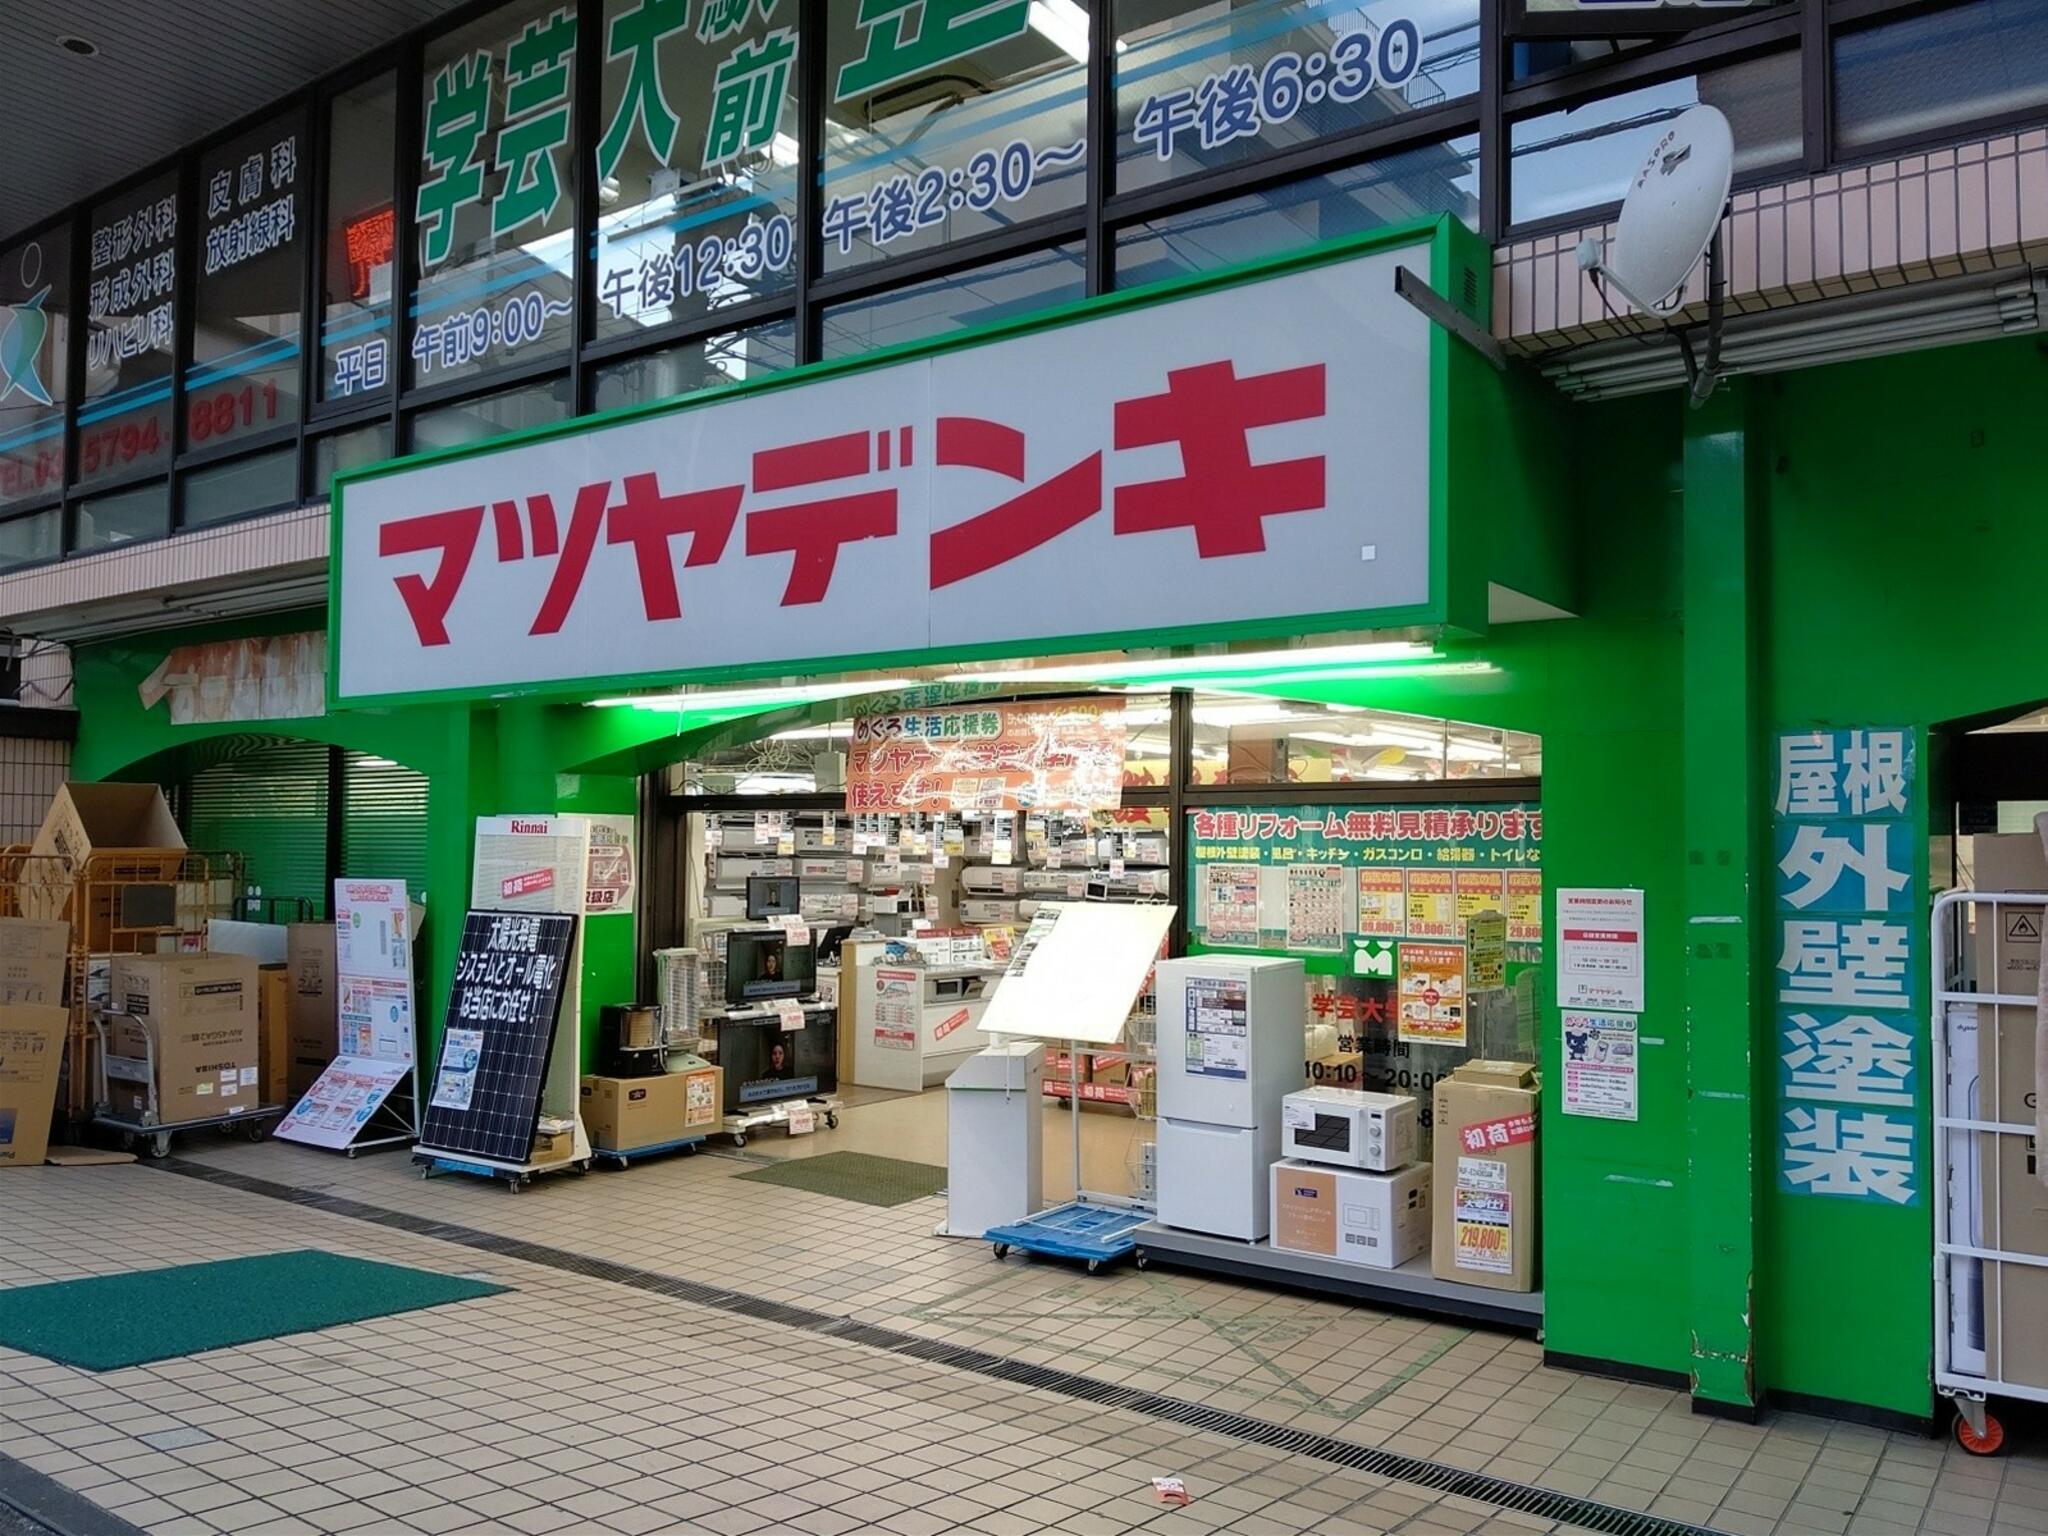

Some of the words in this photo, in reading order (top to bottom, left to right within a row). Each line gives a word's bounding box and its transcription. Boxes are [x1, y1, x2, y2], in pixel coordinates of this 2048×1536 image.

[207, 136, 296, 218] 皮膚科
[90, 194, 177, 271] 整形外科
[335, 339, 388, 396] 平日
[1134, 18, 1425, 162] 午後6:30
[205, 195, 296, 276] 放射線科
[88, 248, 175, 322] 形成外科
[87, 302, 173, 371] リハビリ科
[190, 378, 278, 442] 8811
[379, 359, 1326, 646] マツヤデンキ
[855, 711, 999, 741] めぐろ生活応援券
[511, 820, 548, 834] Rinnai
[1194, 810, 1542, 840] 各種リフォーム無料見積承ります
[487, 917, 541, 952] 太陽光発電
[456, 951, 557, 990] システムとオール電化
[195, 1062, 236, 1073] TOSHIBA
[1337, 1034, 1410, 1058] 営業時間
[1464, 1123, 1509, 1150] 初荷
